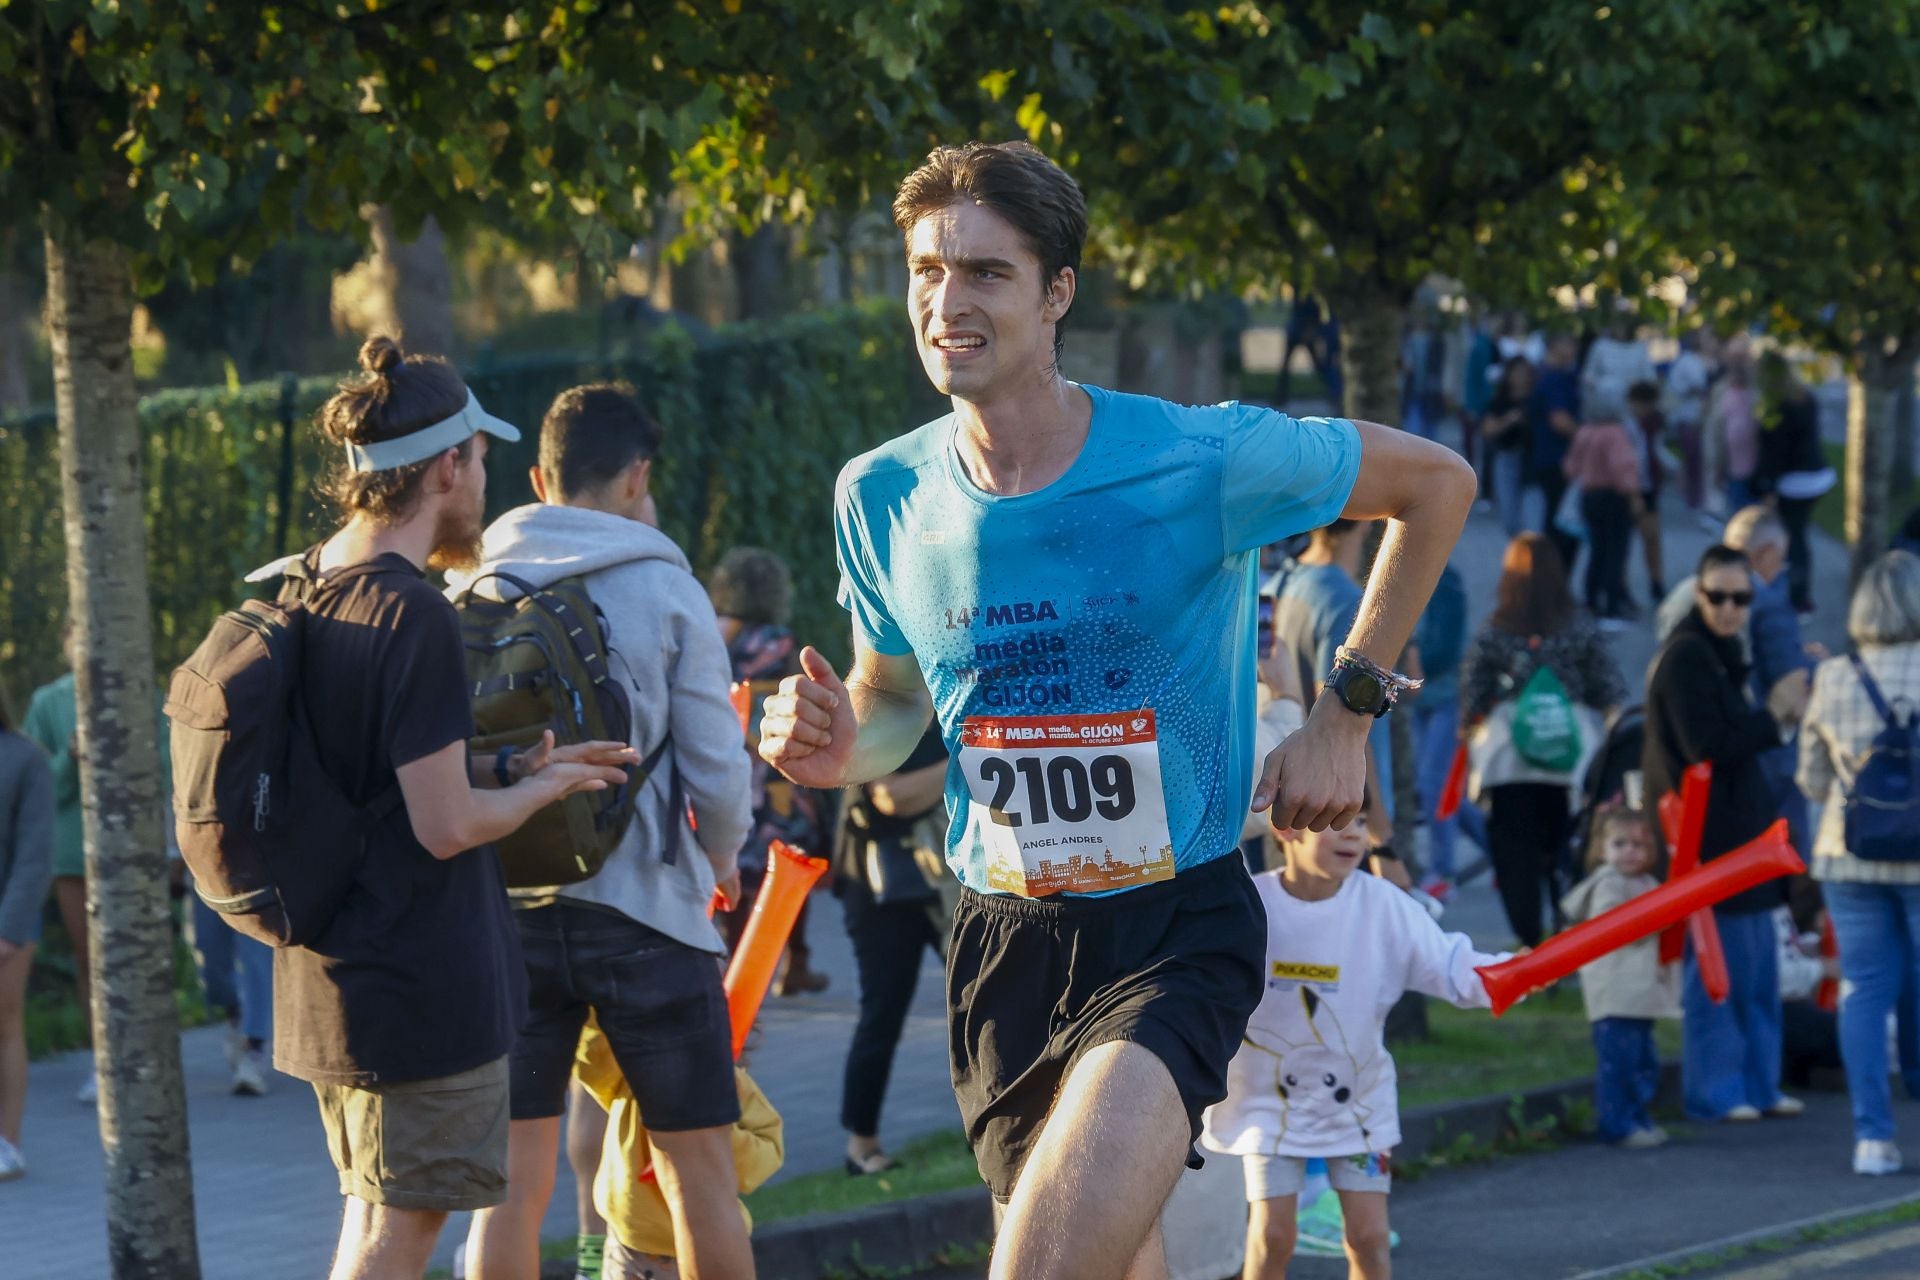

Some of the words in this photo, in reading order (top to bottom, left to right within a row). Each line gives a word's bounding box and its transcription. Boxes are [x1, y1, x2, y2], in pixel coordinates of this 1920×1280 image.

[985, 599, 1059, 627] MBA
[975, 631, 1067, 661] media
[954, 656, 1070, 685] maratón
[982, 678, 1072, 707] GIJÓN
[1005, 727, 1047, 740] MBA
[1049, 731, 1080, 739] maratón
[1080, 722, 1124, 738] GIJÓN
[980, 754, 1137, 828] 2109
[1023, 838, 1059, 850] ANGEL
[1061, 836, 1103, 845] ANDRES
[1276, 964, 1337, 979] PIKACHU
